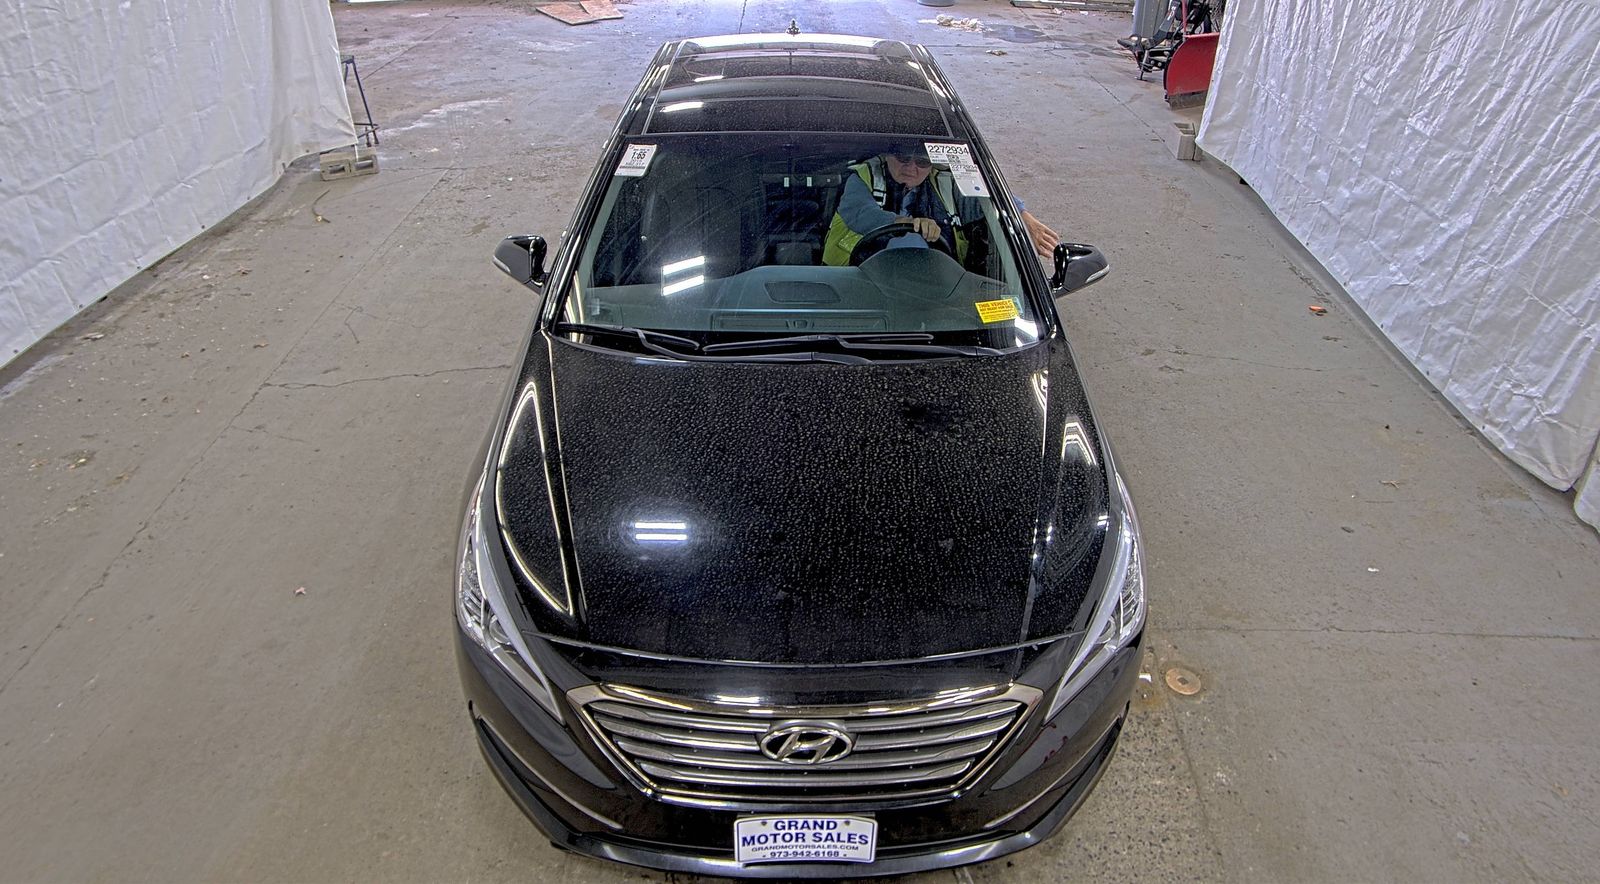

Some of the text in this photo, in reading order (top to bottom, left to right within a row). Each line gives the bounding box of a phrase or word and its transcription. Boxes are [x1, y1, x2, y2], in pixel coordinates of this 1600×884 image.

[928, 145, 969, 154] 2272934
[774, 820, 837, 831] GRAND
[741, 832, 869, 847] MOTOR SALES
[751, 844, 859, 852] GRANDMOTORSALES.COM
[769, 850, 840, 858] 973-942-6168
